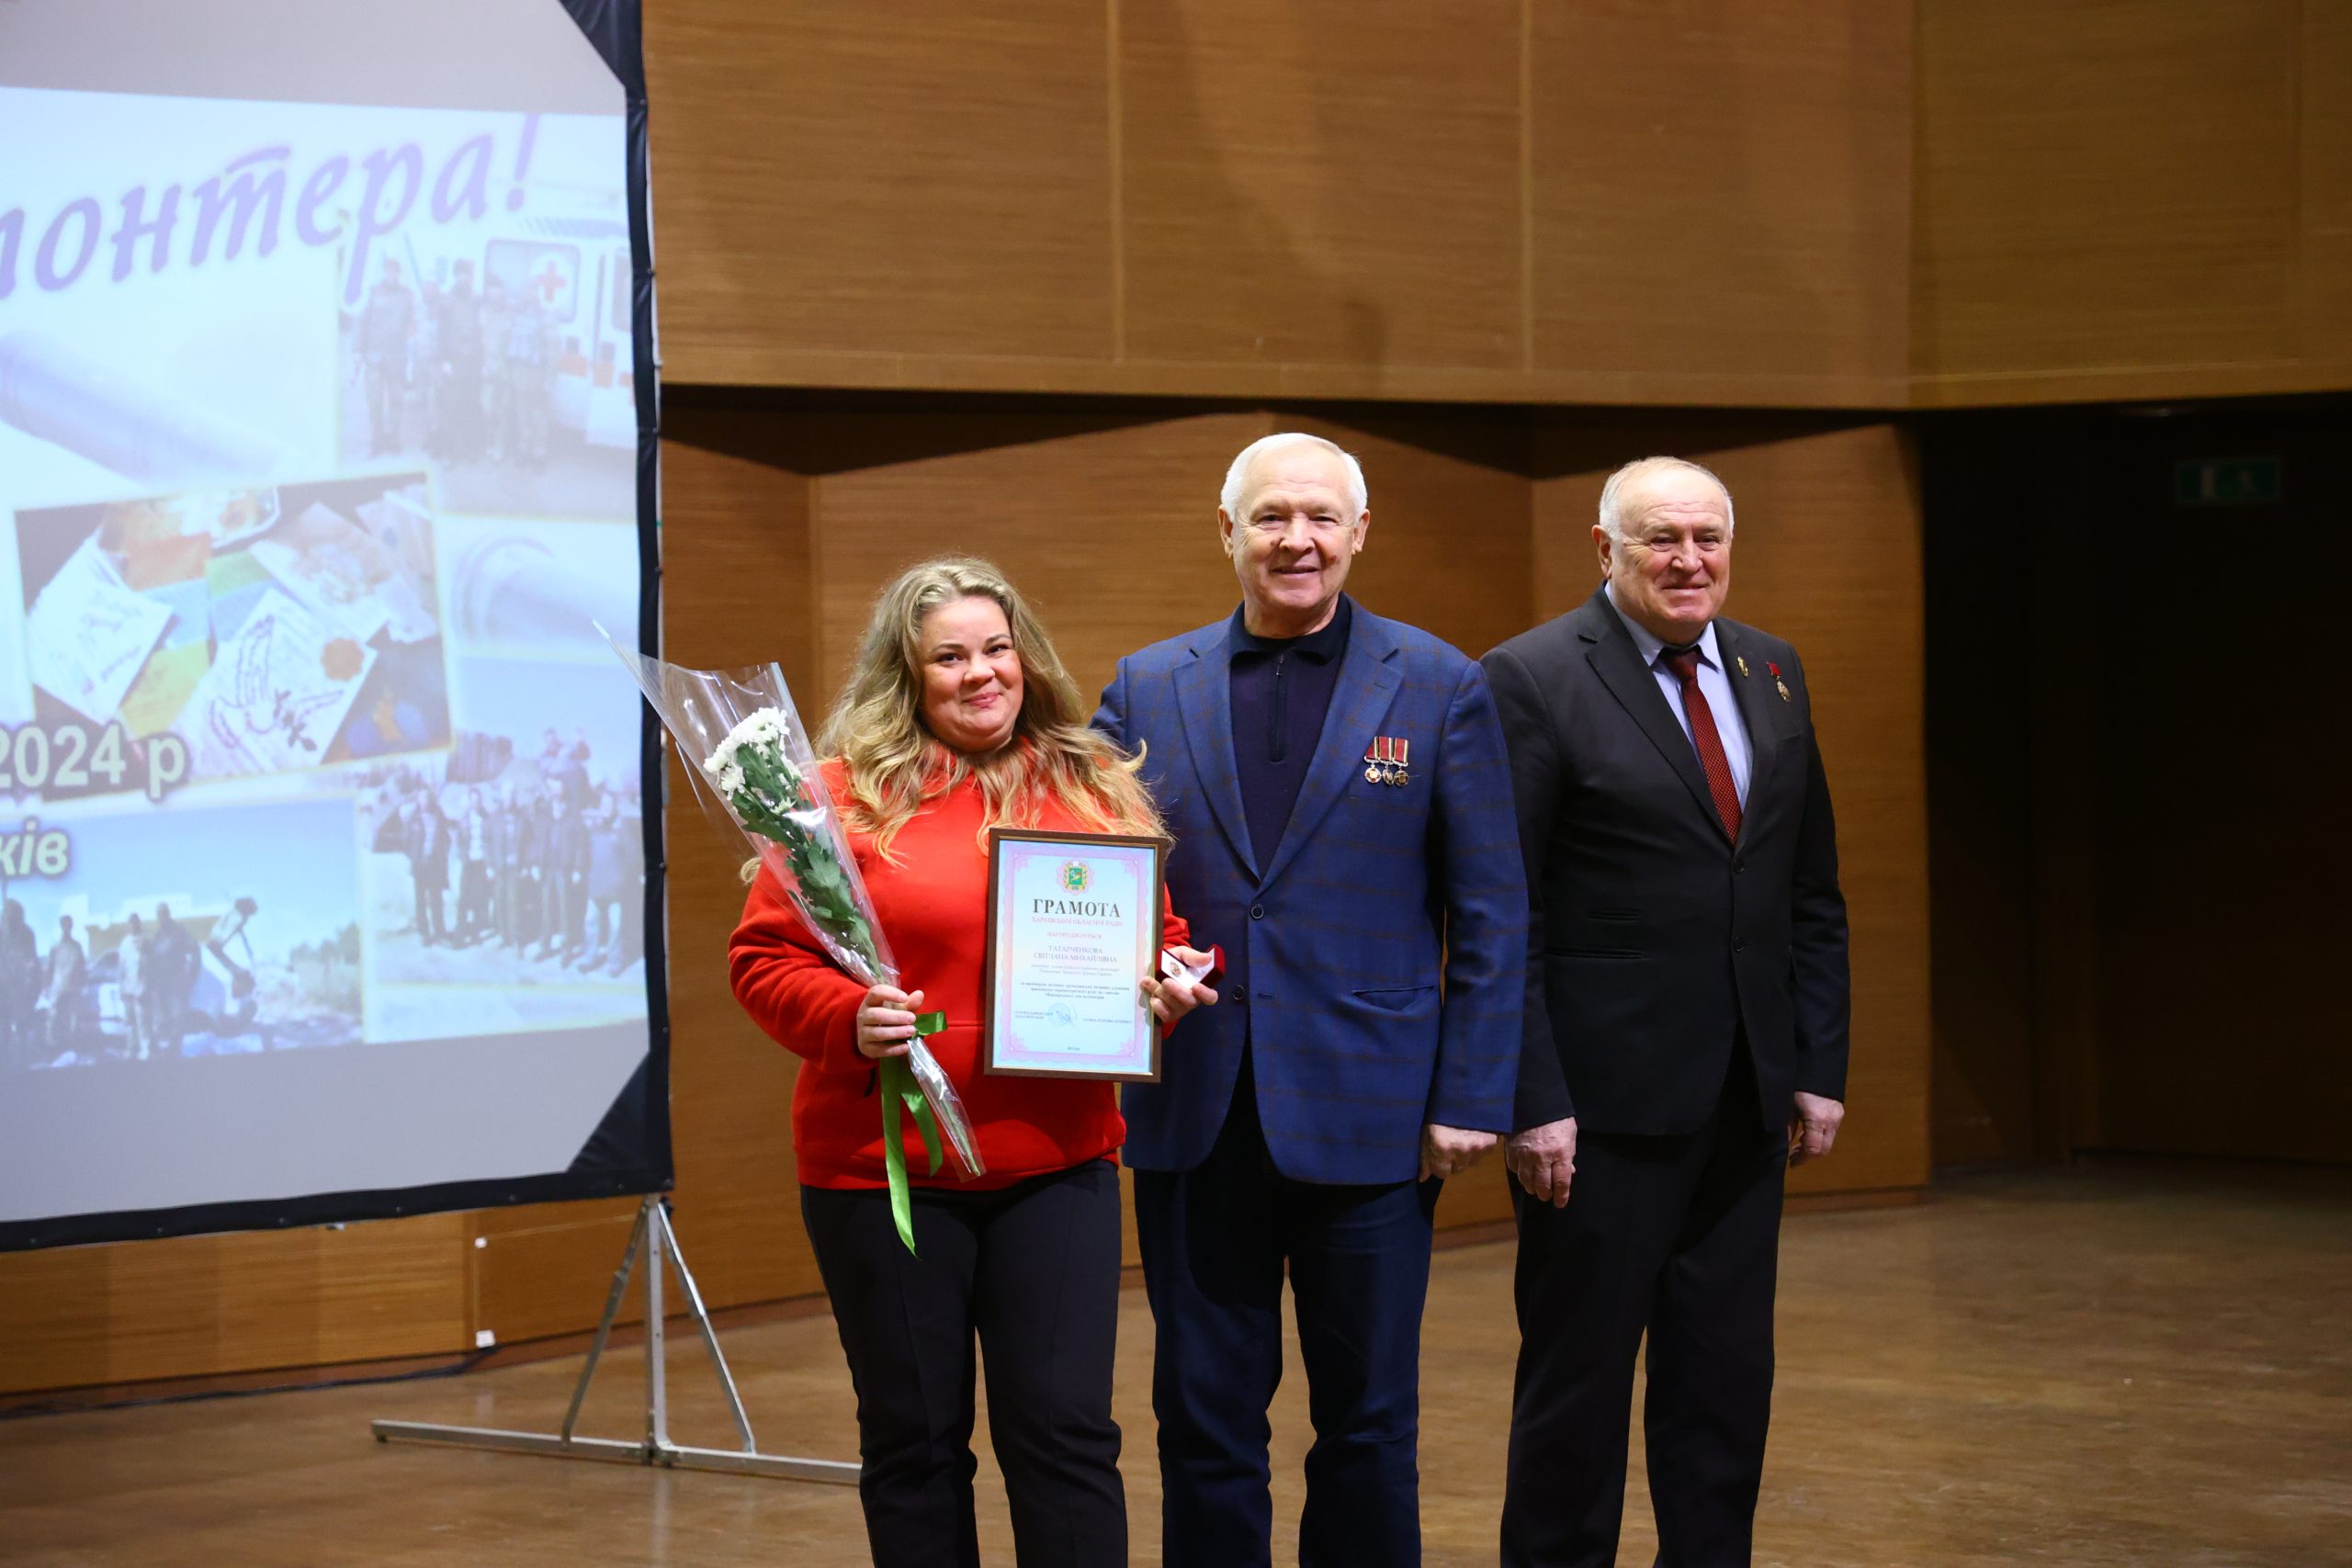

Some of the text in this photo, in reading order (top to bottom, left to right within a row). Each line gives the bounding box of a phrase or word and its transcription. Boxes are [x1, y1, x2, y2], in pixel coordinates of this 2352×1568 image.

[1032, 898, 1121, 918] ГРАМОТА
[1072, 919, 1104, 927] ОБЛАСНОЇ
[1048, 945, 1103, 954] ТАТАРЧЕНКОВА
[1033, 953, 1117, 964] СВІТЛАНА МИХАЙЛІВНА
